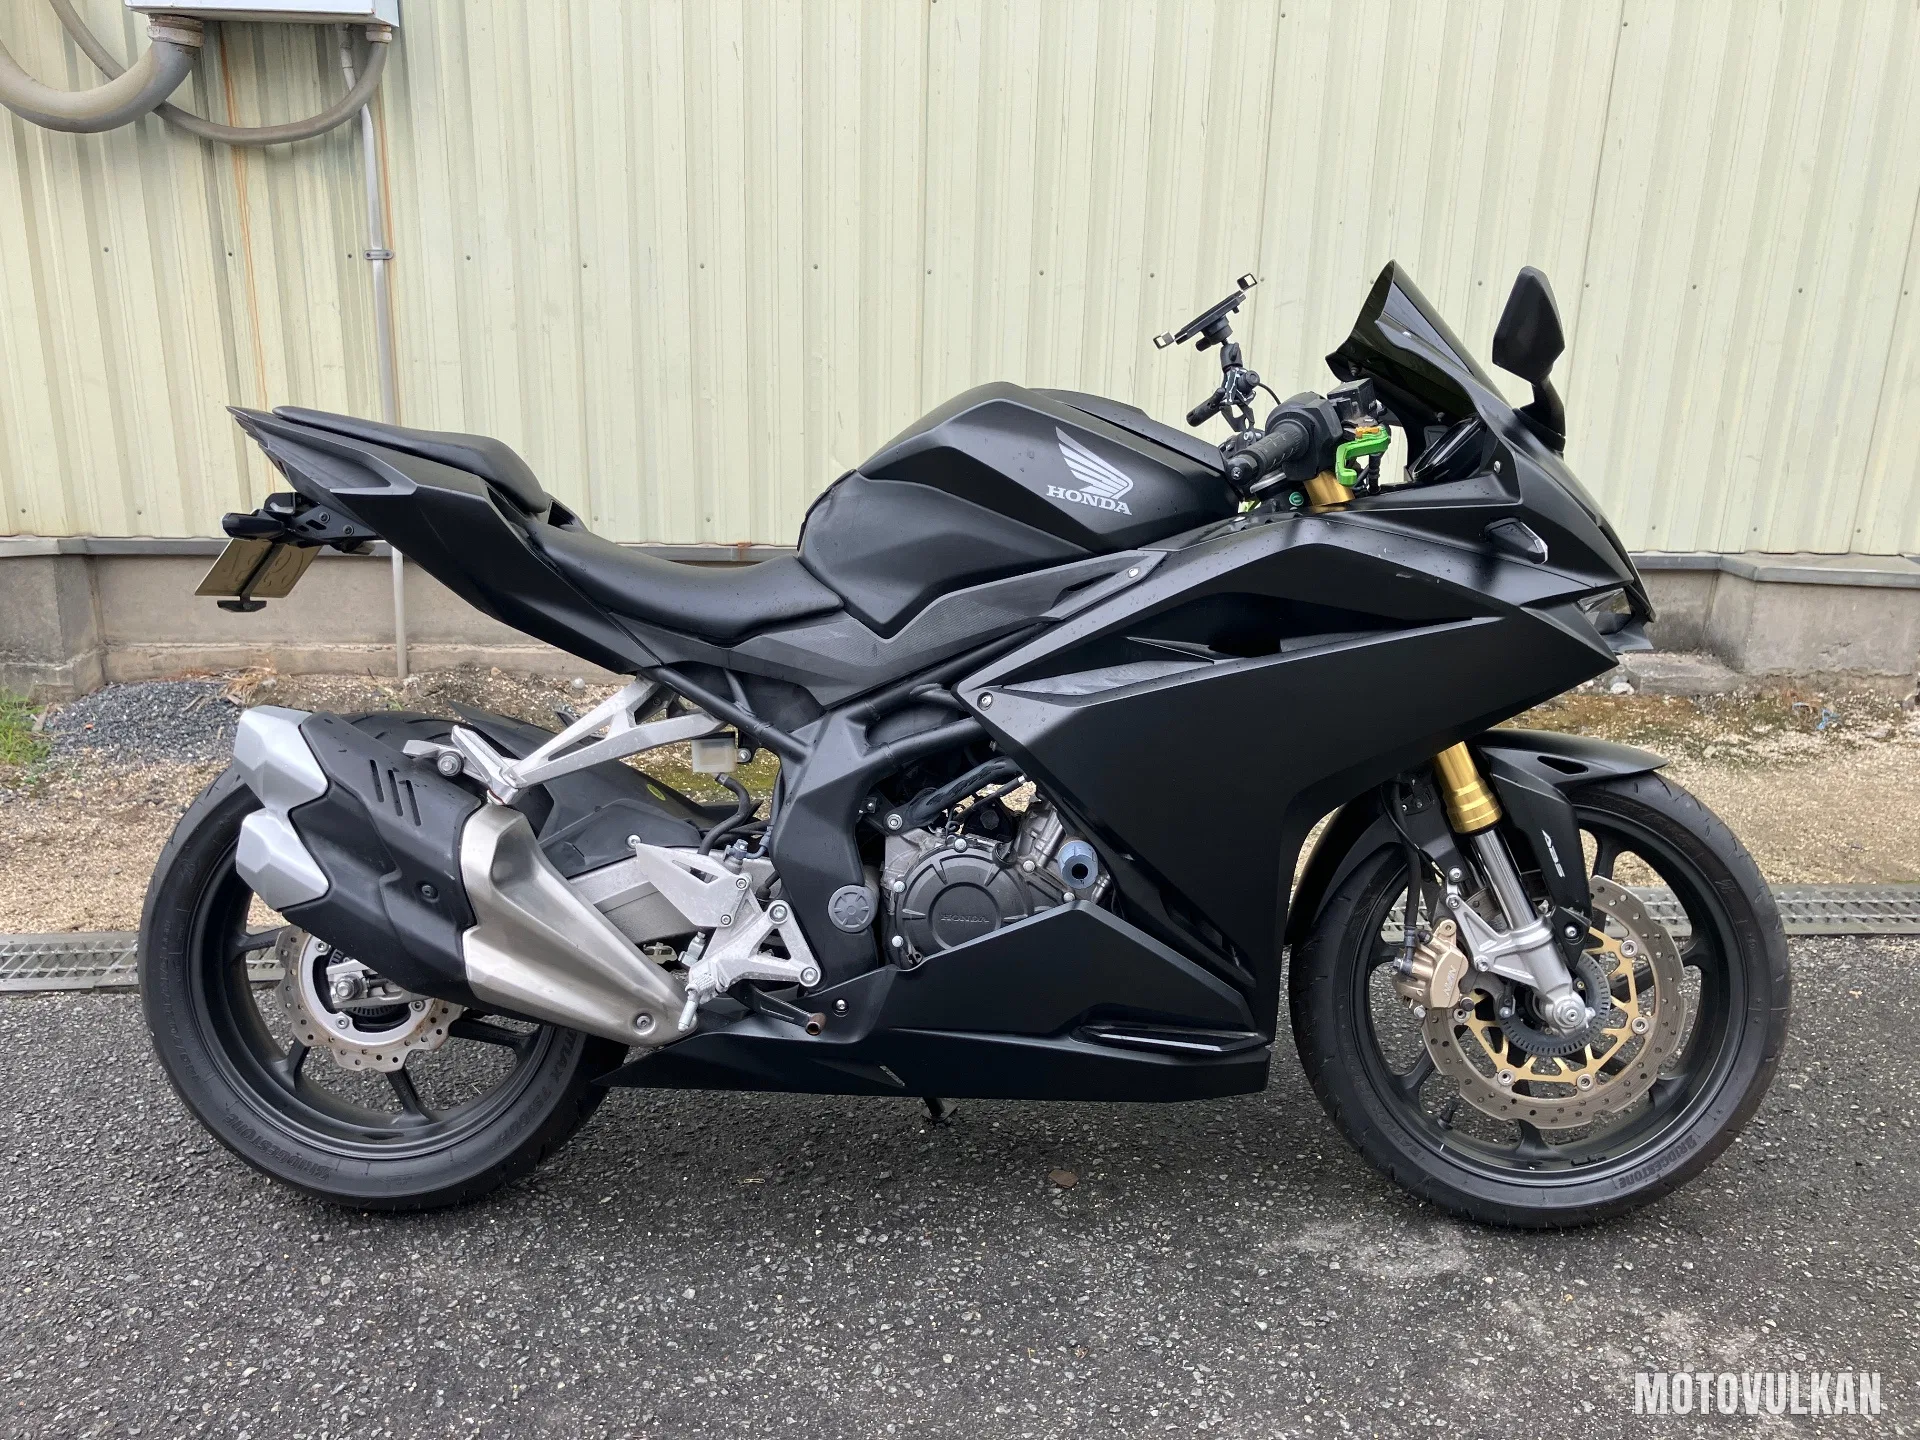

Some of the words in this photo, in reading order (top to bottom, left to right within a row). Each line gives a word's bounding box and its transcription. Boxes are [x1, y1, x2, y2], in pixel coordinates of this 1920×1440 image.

[1046, 485, 1132, 515] HONDA
[941, 914, 989, 922] HONDA
[223, 1113, 331, 1180] BRIDGESTONE
[1618, 1135, 1698, 1188] BRIDGESTONE
